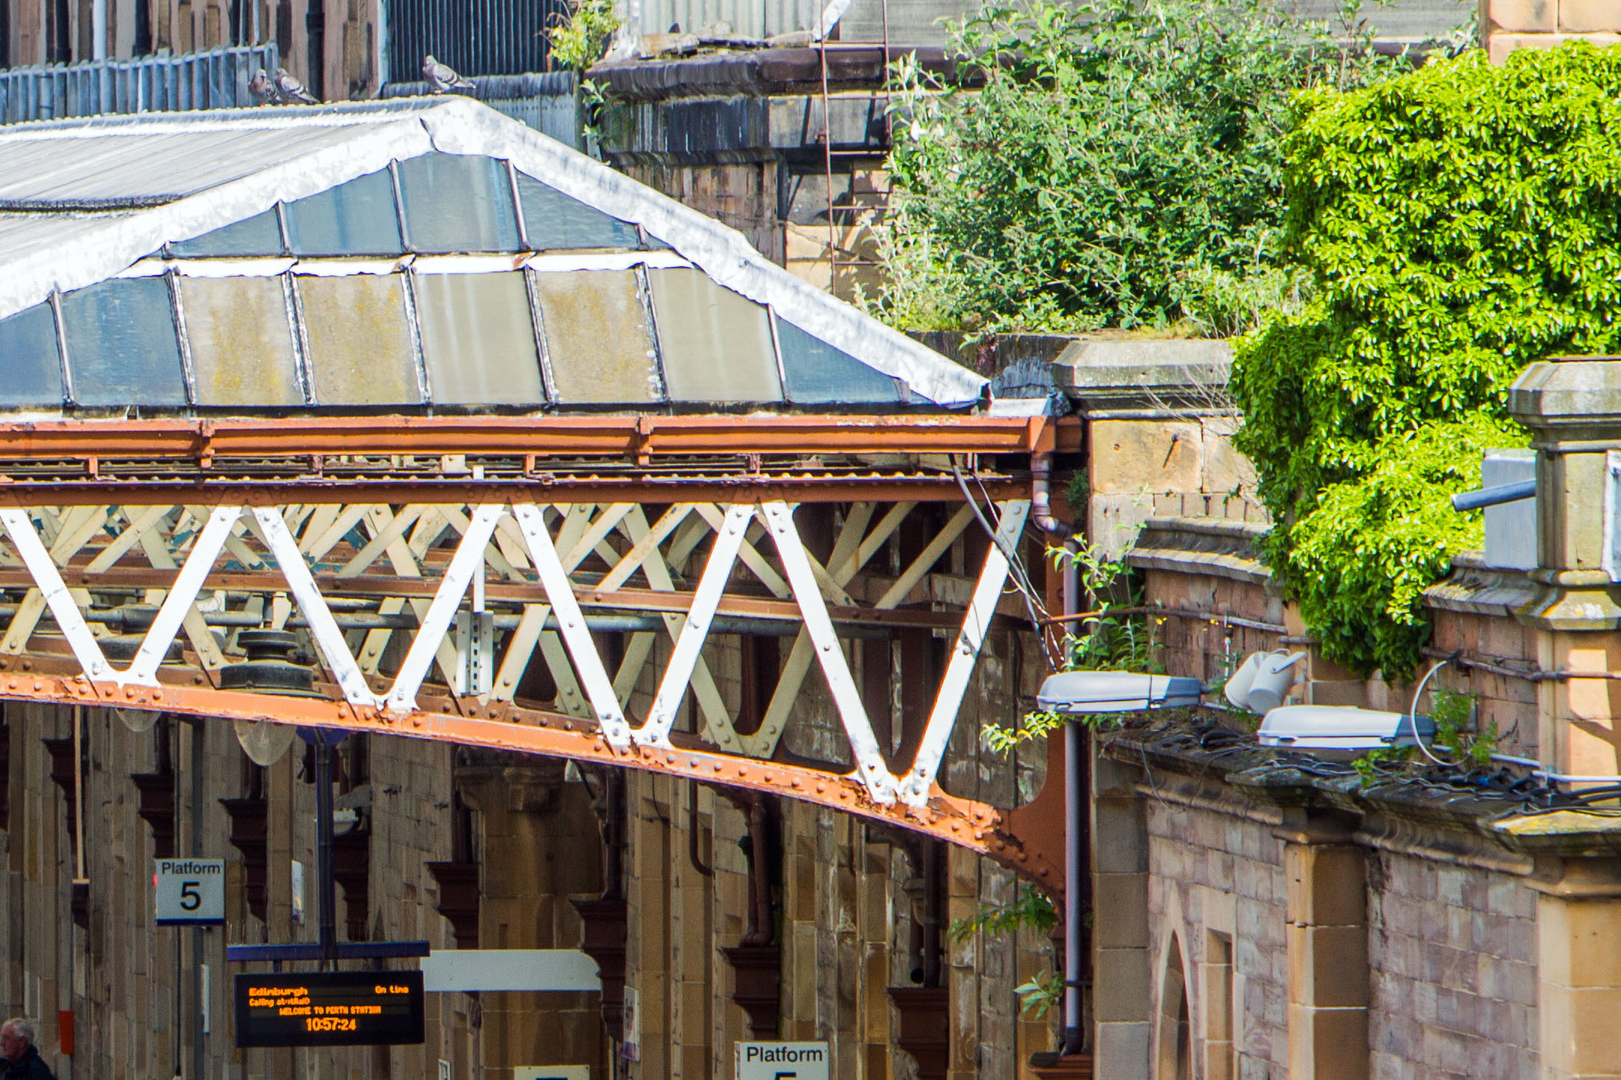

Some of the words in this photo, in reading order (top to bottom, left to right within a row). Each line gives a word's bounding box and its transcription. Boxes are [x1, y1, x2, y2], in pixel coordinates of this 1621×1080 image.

[161, 861, 221, 875] Platform
[180, 881, 201, 911] 5
[248, 987, 308, 997] Edinburgh
[375, 985, 387, 994] On
[249, 998, 275, 1007] Calling
[279, 1007, 311, 1016] WELCOME
[314, 1006, 324, 1015] TO
[325, 1006, 349, 1015] PERTH
[350, 1006, 381, 1014] STATION
[306, 1017, 357, 1031] 10:57:24
[747, 1046, 823, 1063] Platform
